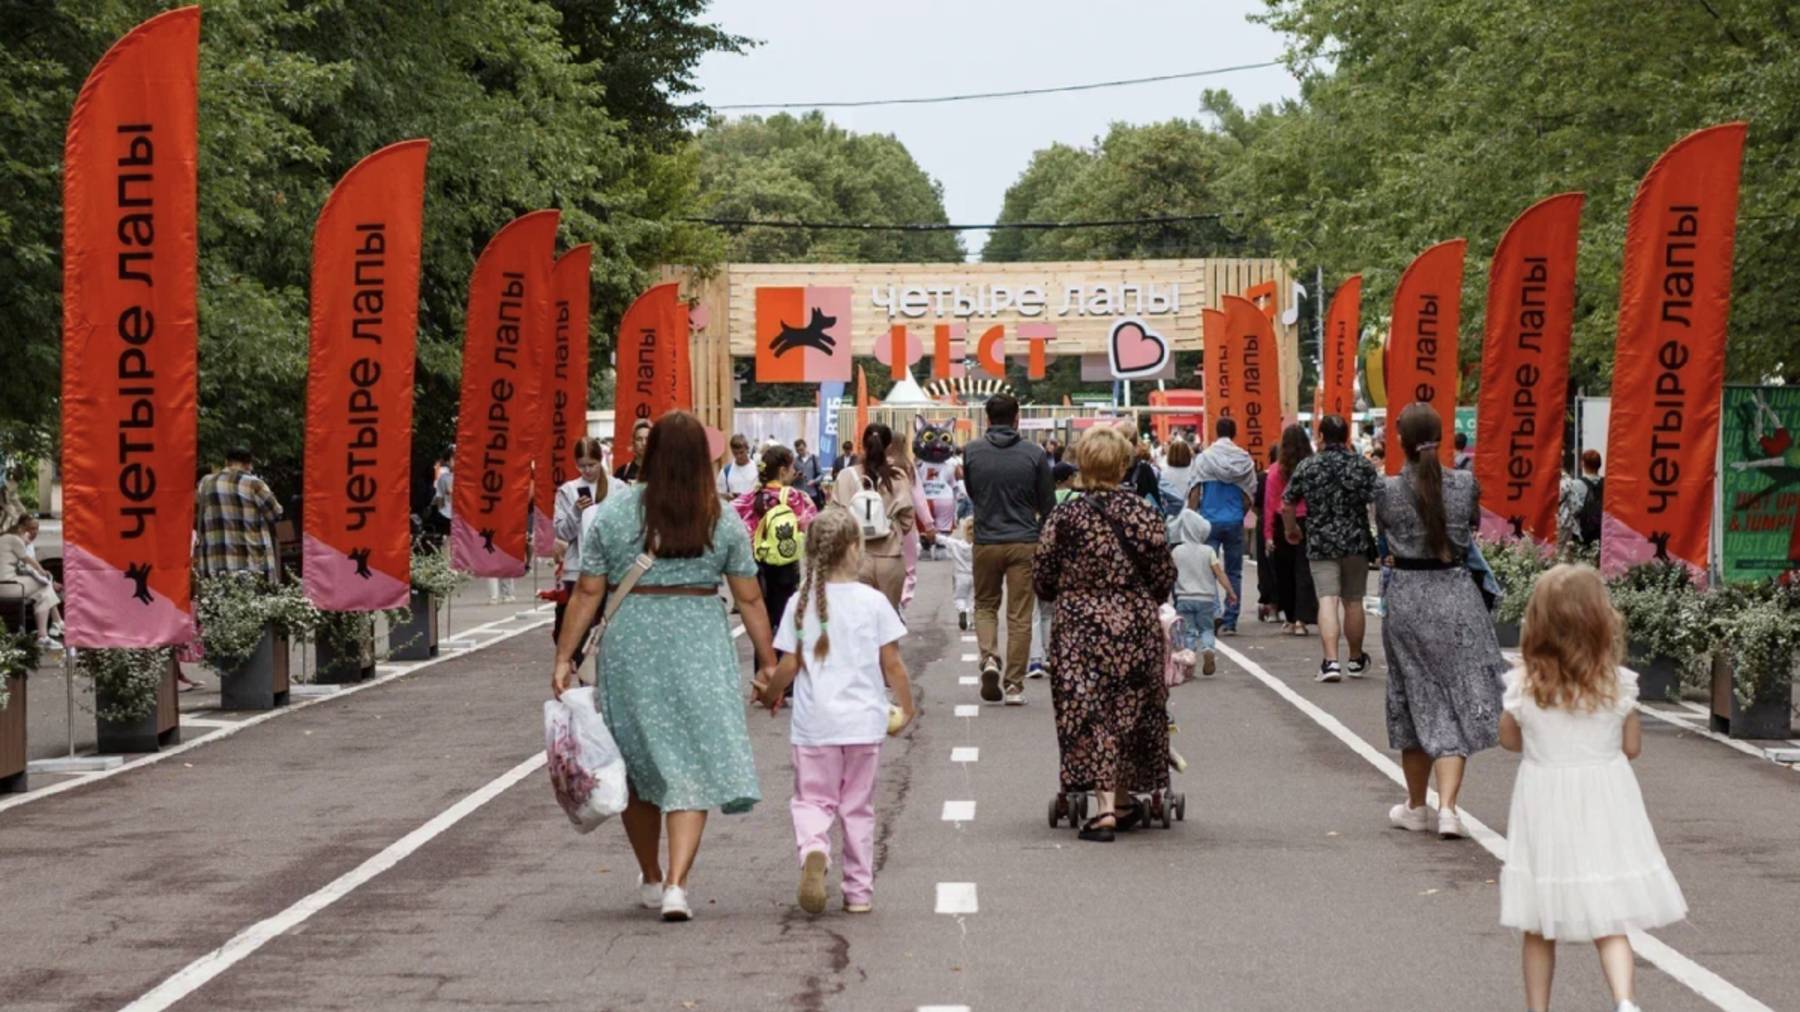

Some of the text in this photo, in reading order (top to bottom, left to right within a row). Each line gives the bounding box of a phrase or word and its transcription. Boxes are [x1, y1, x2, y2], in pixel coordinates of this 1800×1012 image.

[117, 123, 156, 540] четыре лапы
[554, 300, 570, 381] лапы
[872, 282, 1181, 318] четыре лапы
[1416, 294, 1439, 377] лапы
[346, 223, 385, 532] четыре лапы
[480, 271, 524, 515] четыре лапы
[636, 328, 656, 396] лапы
[1243, 335, 1261, 395] лапы
[1507, 256, 1547, 502] четыре лапы
[1647, 205, 1698, 514] четыре лапы
[825, 397, 841, 434] ВТБ
